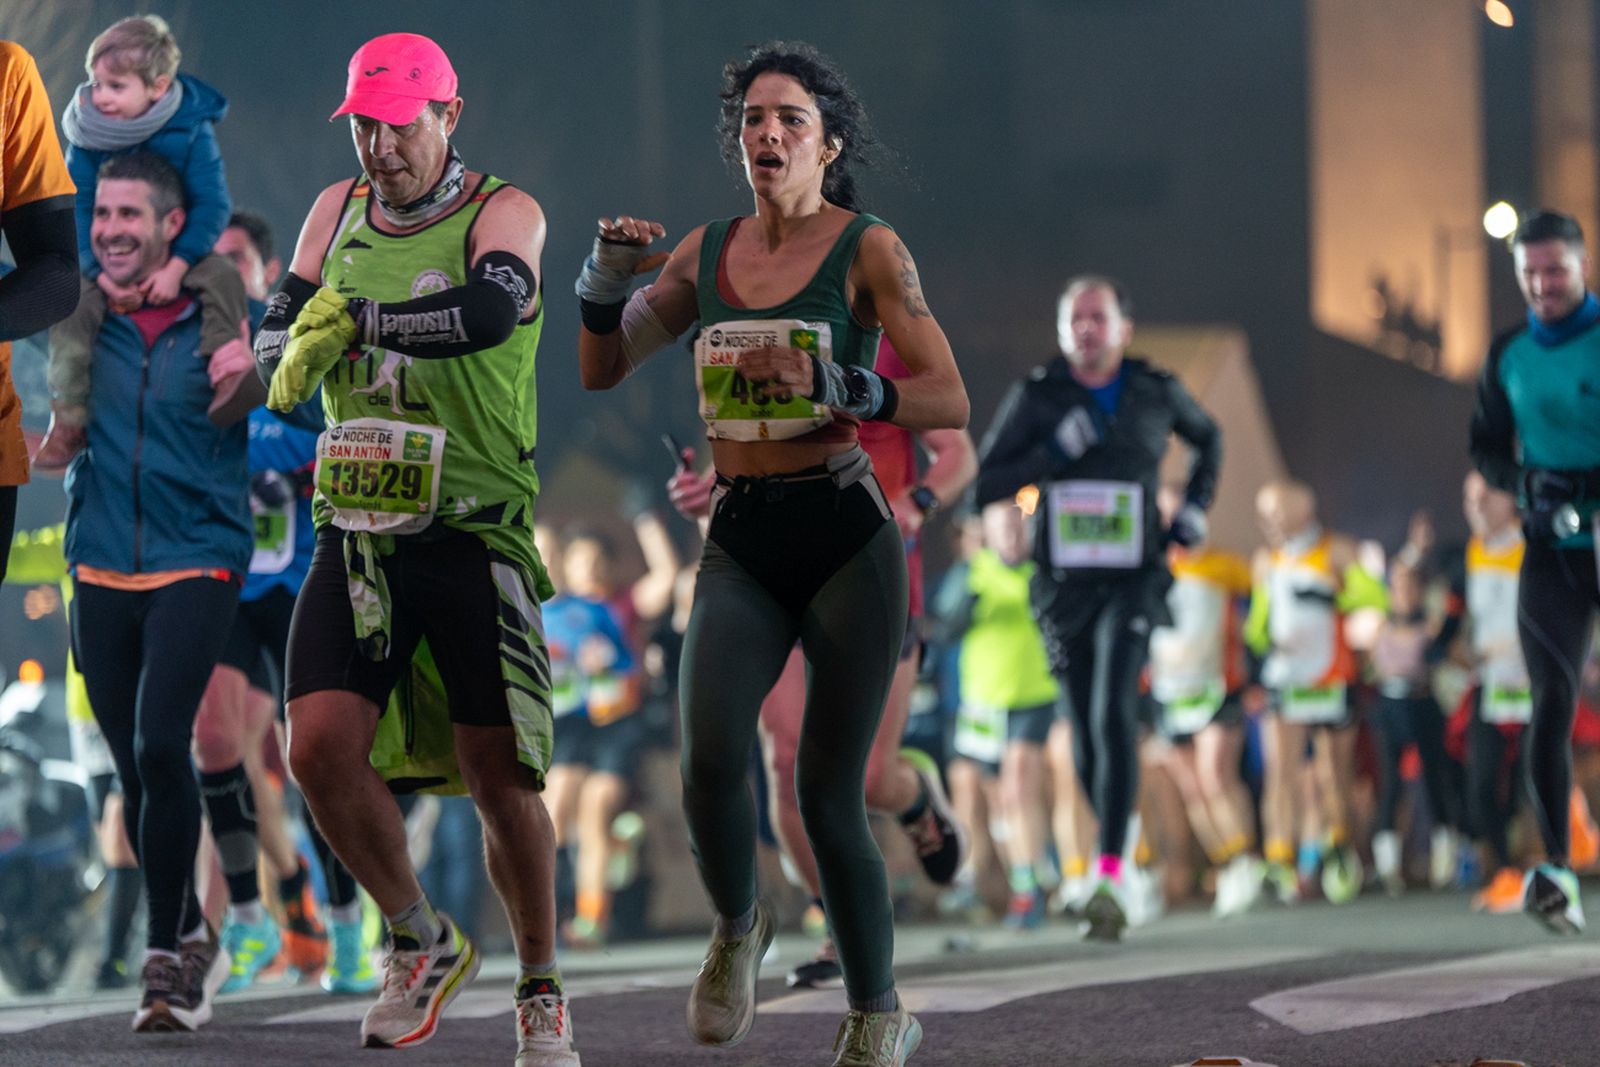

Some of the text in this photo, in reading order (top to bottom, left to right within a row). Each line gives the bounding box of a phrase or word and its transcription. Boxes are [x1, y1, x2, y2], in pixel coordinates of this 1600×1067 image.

[724, 335, 778, 347] NOCHE DE
[343, 431, 393, 444] NOCHE DE
[329, 445, 351, 458] SAN
[329, 462, 422, 500] 13529
